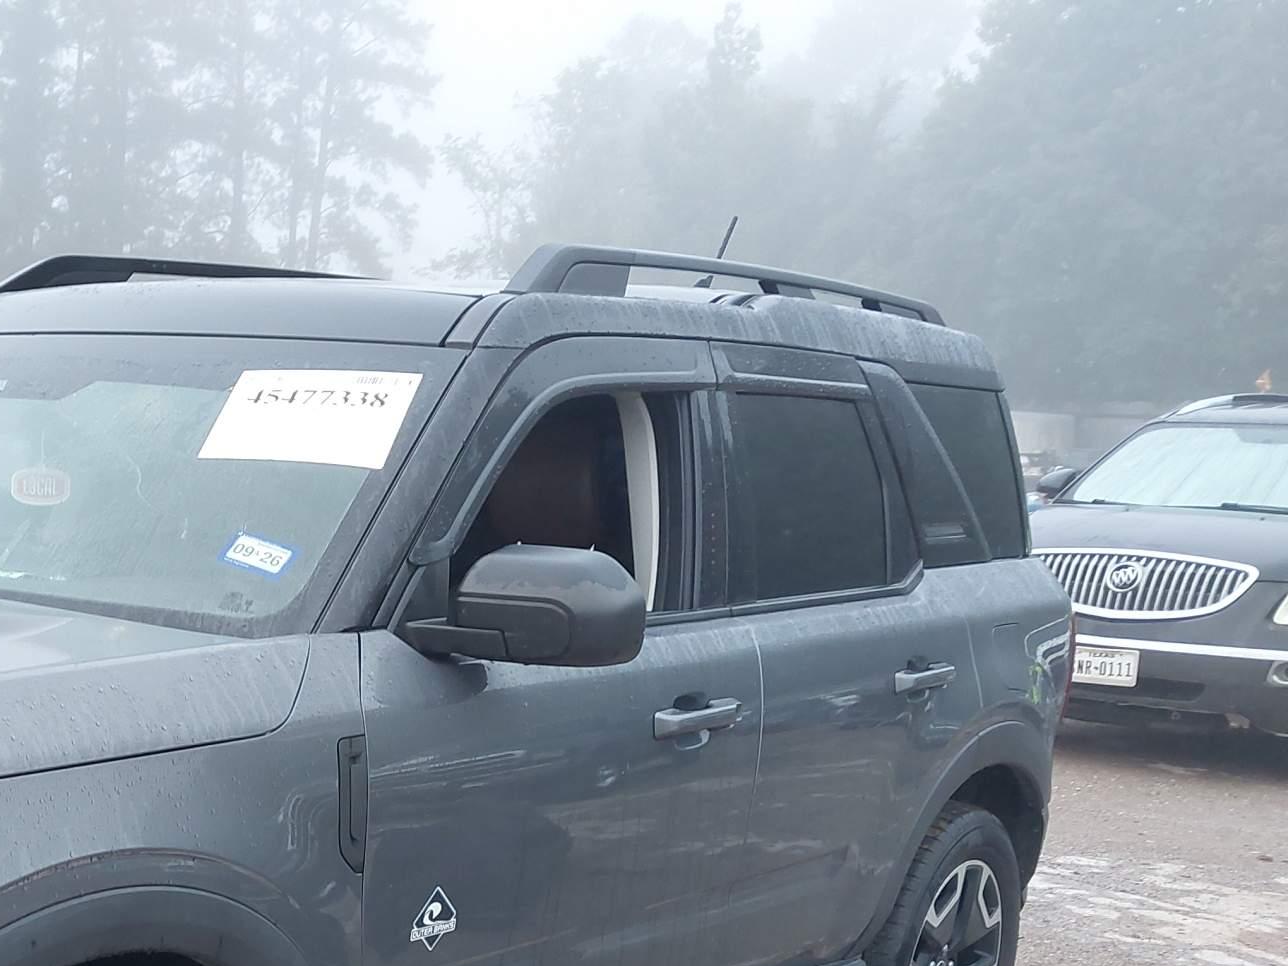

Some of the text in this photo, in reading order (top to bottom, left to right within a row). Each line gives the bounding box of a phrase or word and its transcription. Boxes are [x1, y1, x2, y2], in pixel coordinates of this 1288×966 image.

[247, 389, 388, 407] 45477338
[233, 543, 255, 557] 09
[258, 551, 283, 567] 26
